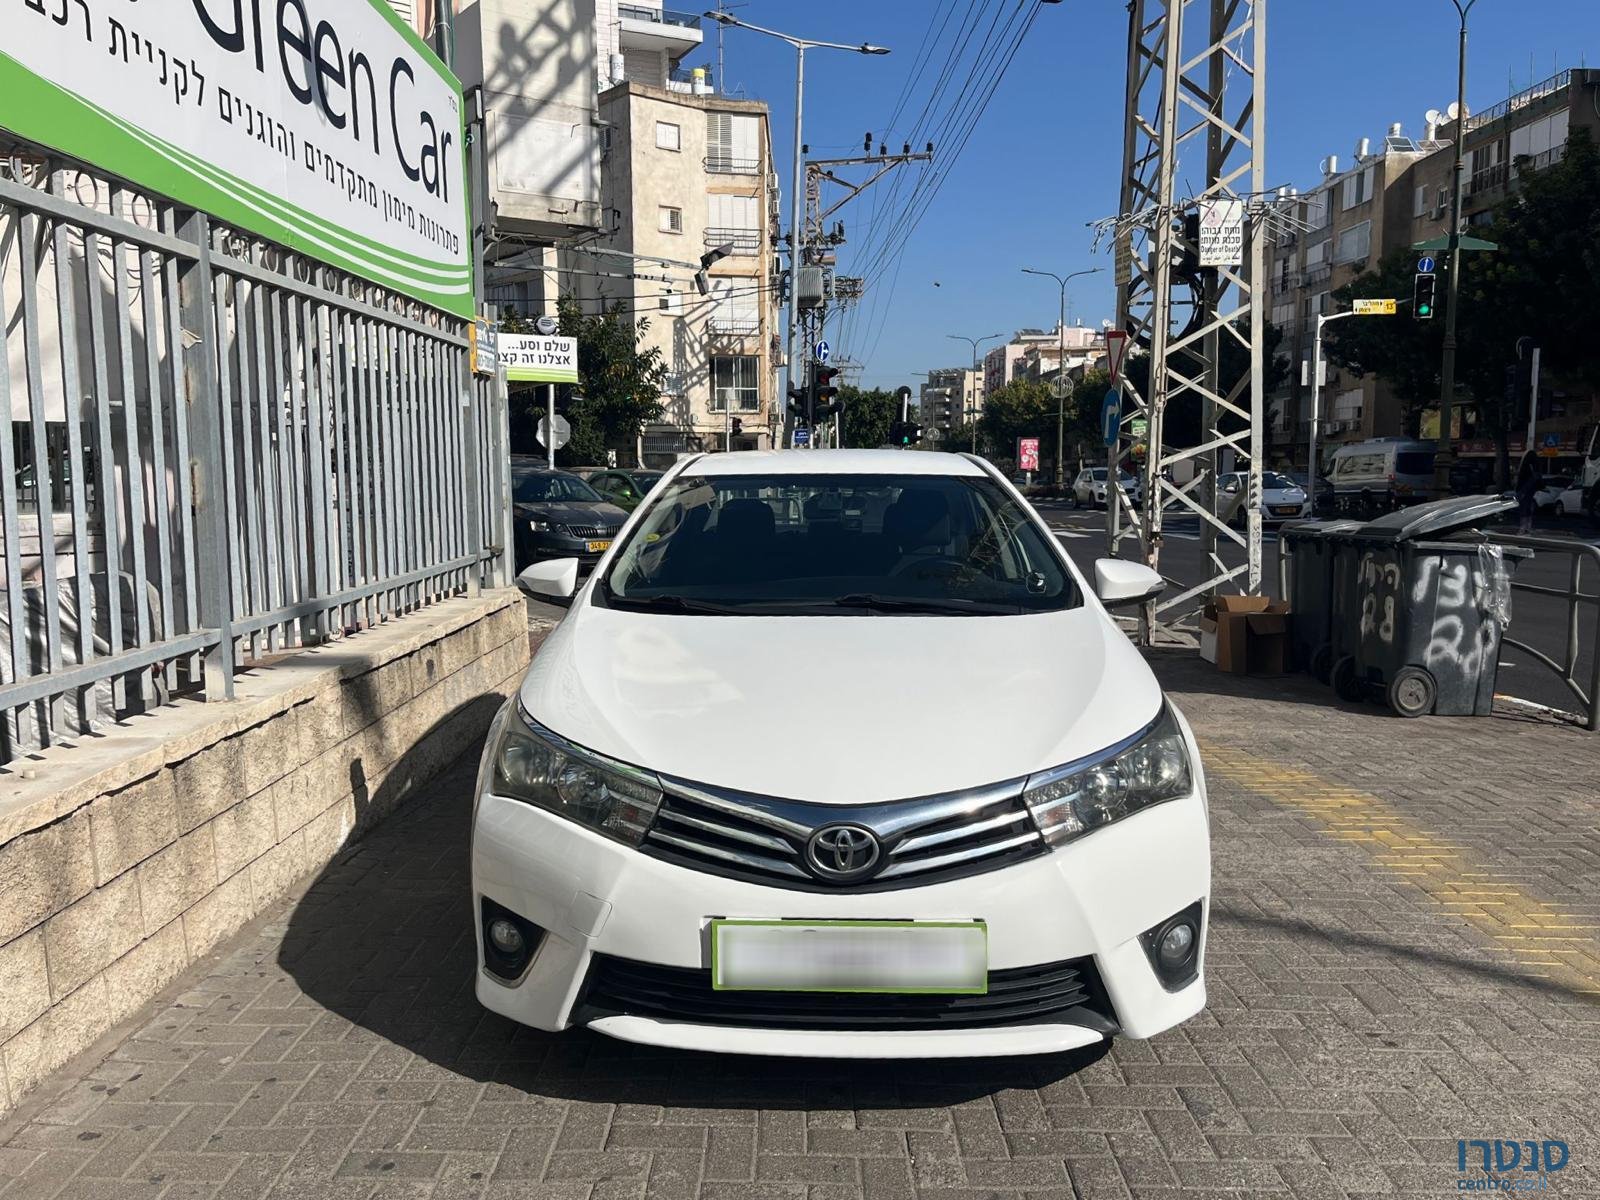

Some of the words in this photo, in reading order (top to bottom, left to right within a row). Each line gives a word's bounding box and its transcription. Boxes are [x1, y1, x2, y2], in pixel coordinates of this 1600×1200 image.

[108, 16, 204, 106] לקניית
[218, 86, 295, 160] והוגנים
[390, 57, 452, 203] Car
[304, 140, 378, 208] מתקדמים
[382, 190, 415, 230] מימון
[419, 213, 458, 255] פתרונות
[508, 340, 540, 350] וסע...
[522, 353, 534, 363] זה
[539, 352, 570, 365] אצלנו
[545, 340, 570, 352] שלם
